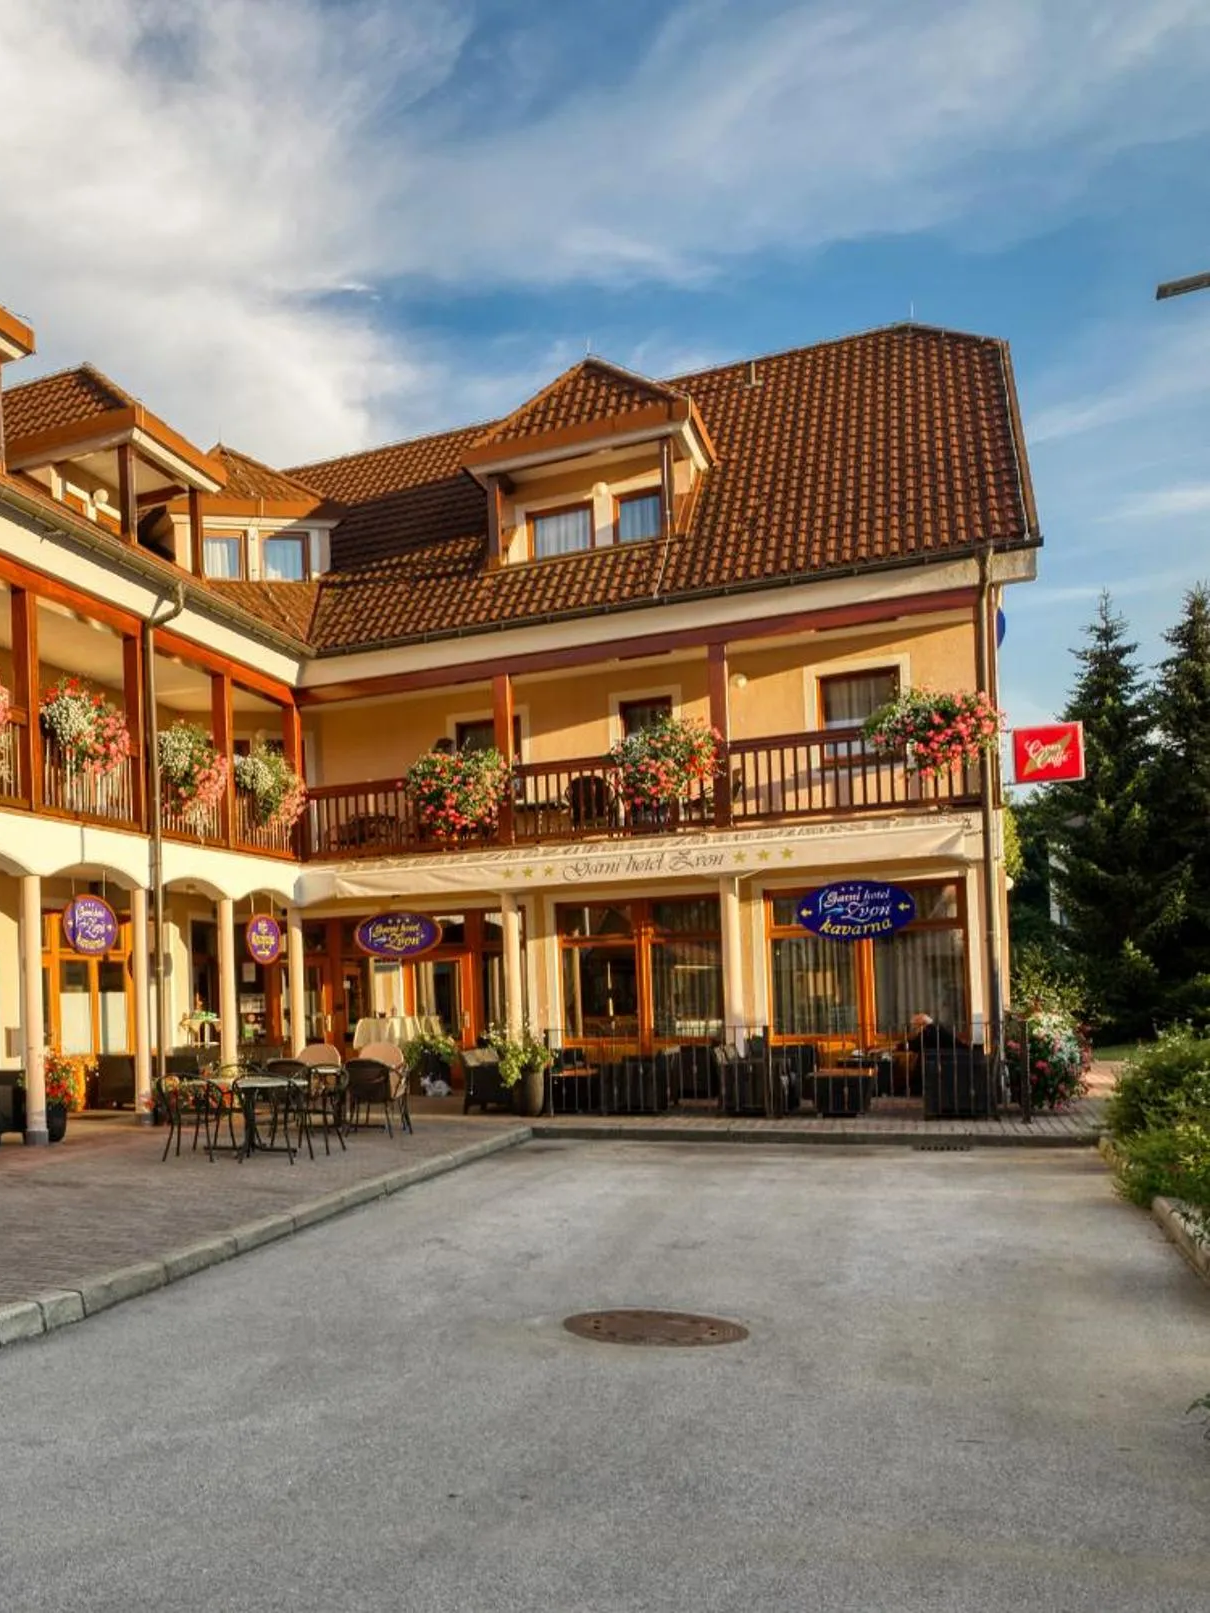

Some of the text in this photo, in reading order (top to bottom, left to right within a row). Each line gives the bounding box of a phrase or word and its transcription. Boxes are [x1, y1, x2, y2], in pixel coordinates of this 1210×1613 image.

[562, 852, 724, 881] Garni hotel Zvon
[823, 888, 891, 908] Garni hotel
[841, 901, 892, 923] Zvon
[819, 915, 892, 936] kavarna
